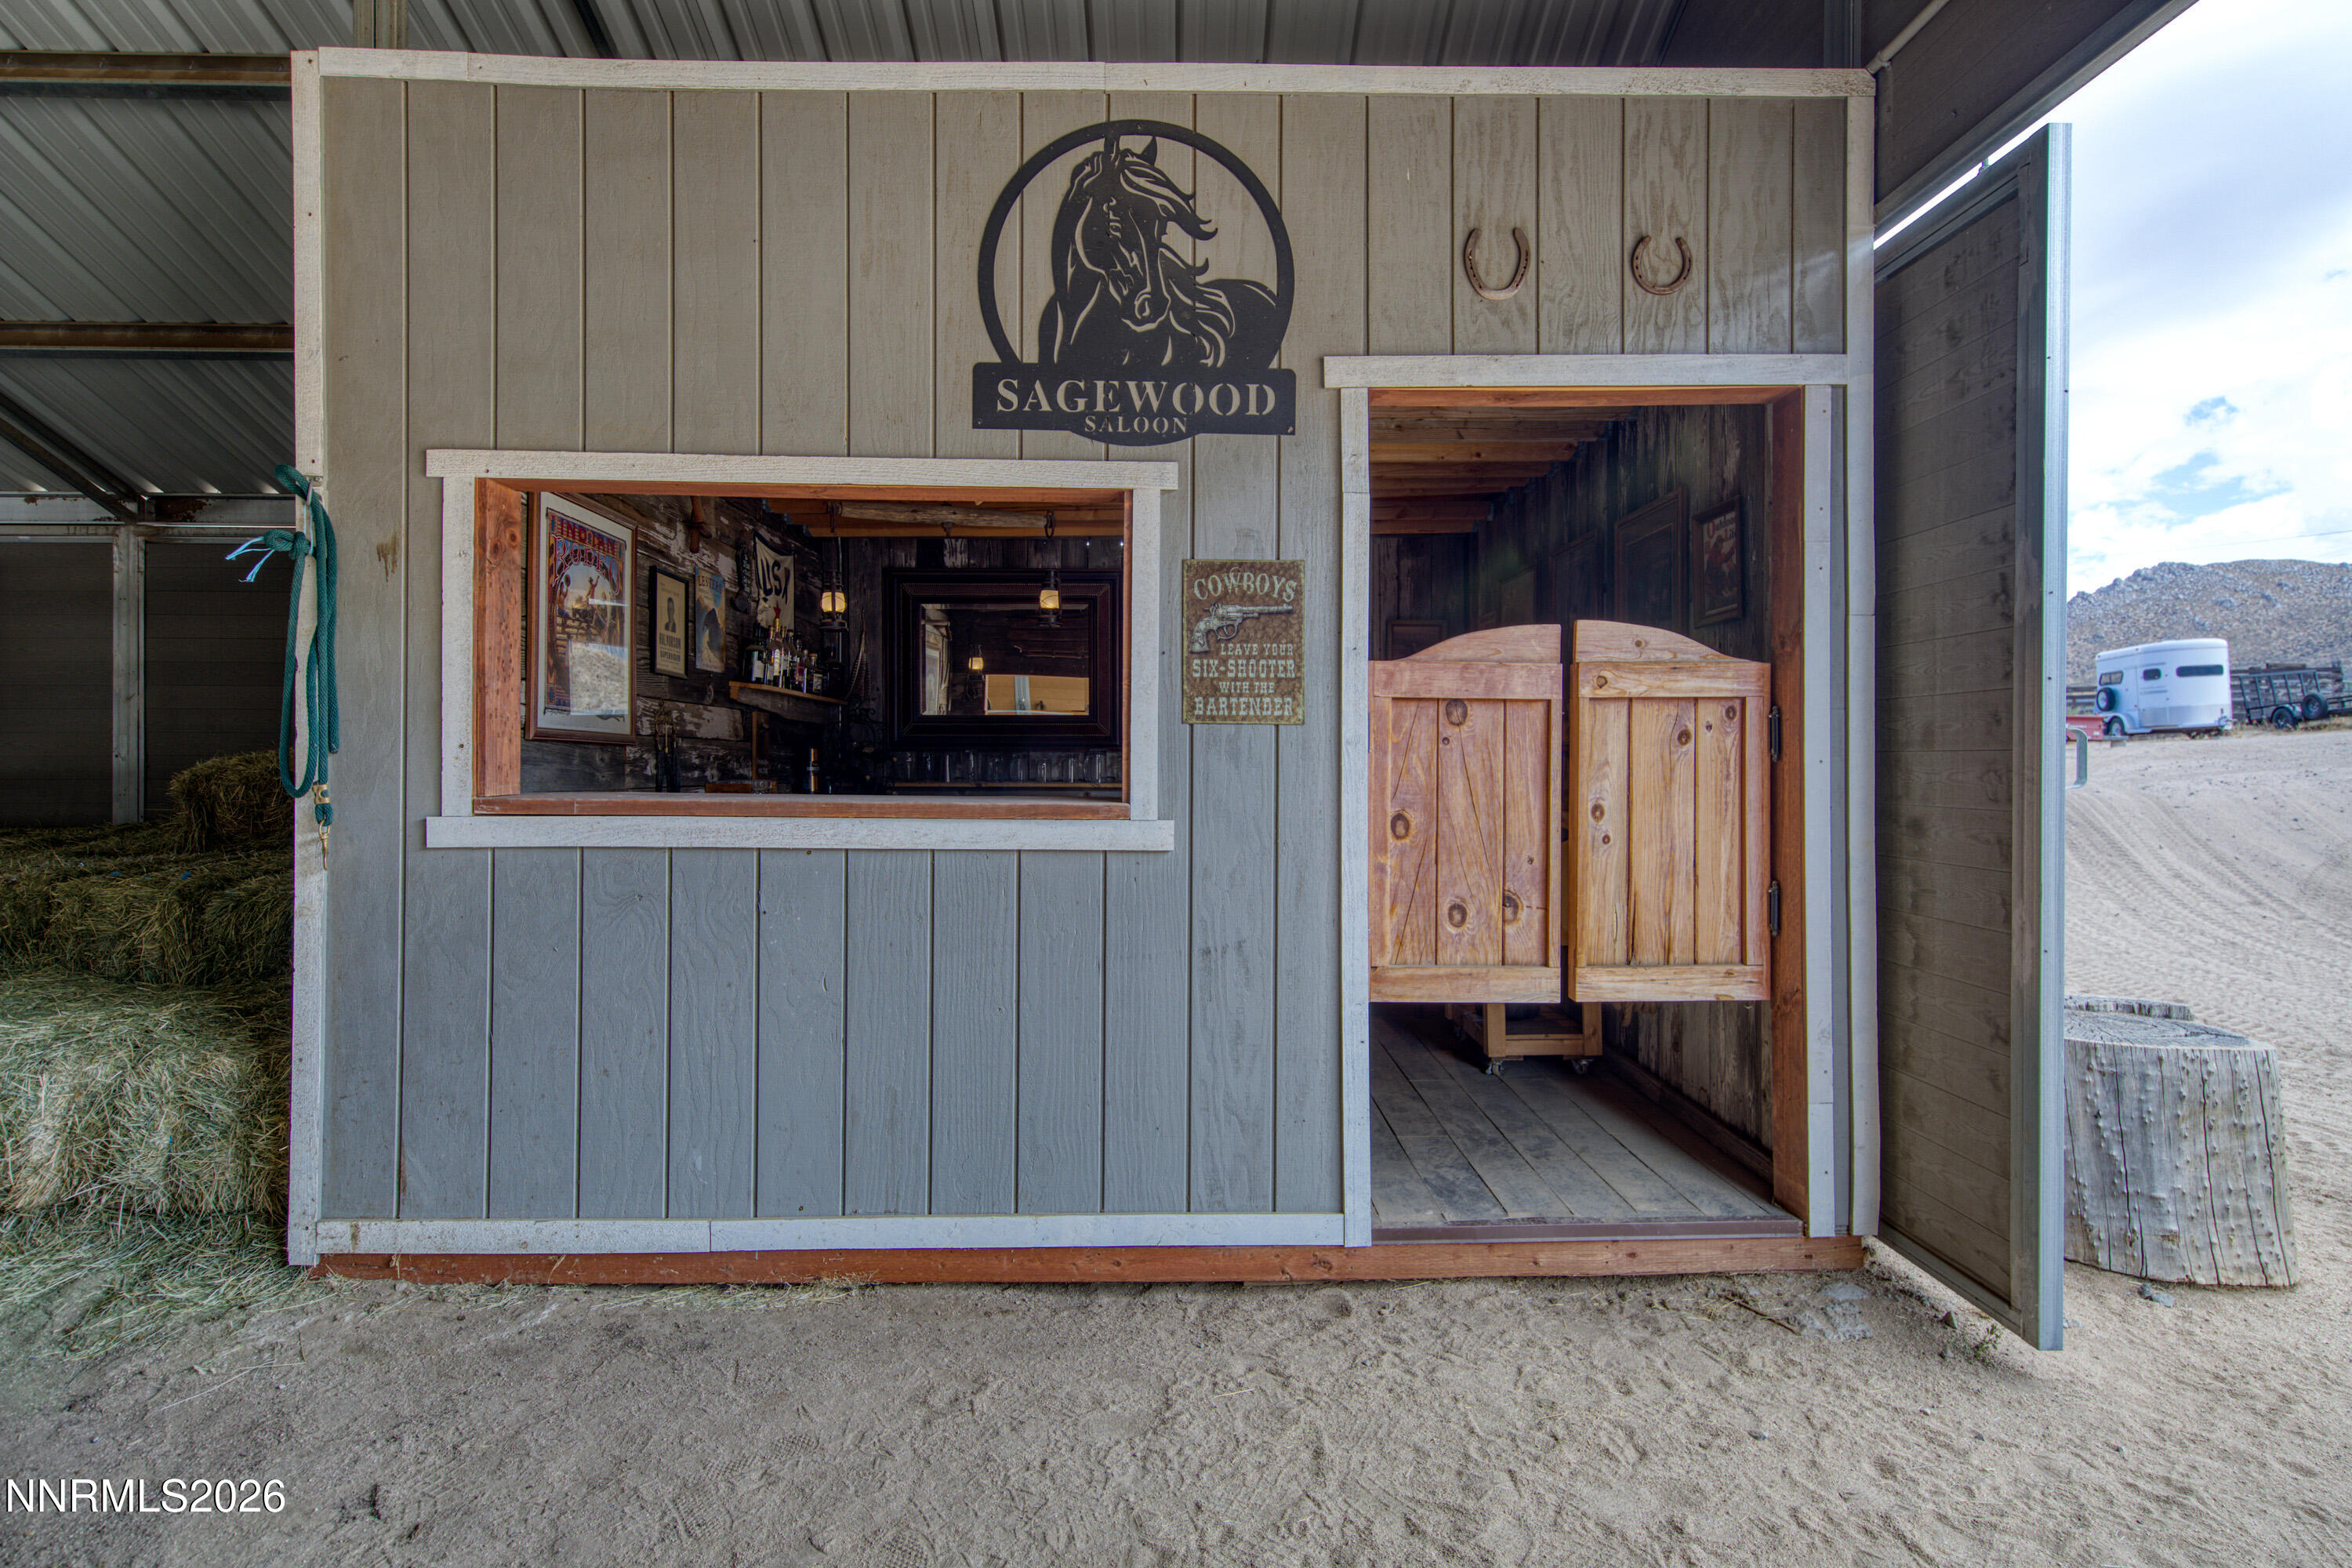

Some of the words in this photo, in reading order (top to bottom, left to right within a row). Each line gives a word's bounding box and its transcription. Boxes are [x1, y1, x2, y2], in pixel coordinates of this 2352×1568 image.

[996, 379, 1276, 416] SAGEWOOD
[1084, 416, 1188, 434] SALOON
[557, 517, 616, 557] INDIAN
[551, 533, 620, 596] RODEO
[1193, 571, 1298, 602] COWBOYS
[1220, 643, 1258, 655] LEAVE
[1263, 643, 1294, 656] YOUR
[1192, 659, 1296, 678] SIX-SHOOTER
[1218, 681, 1250, 694] WITH
[1254, 681, 1275, 693] THE
[1194, 697, 1294, 717] BARTENDER
